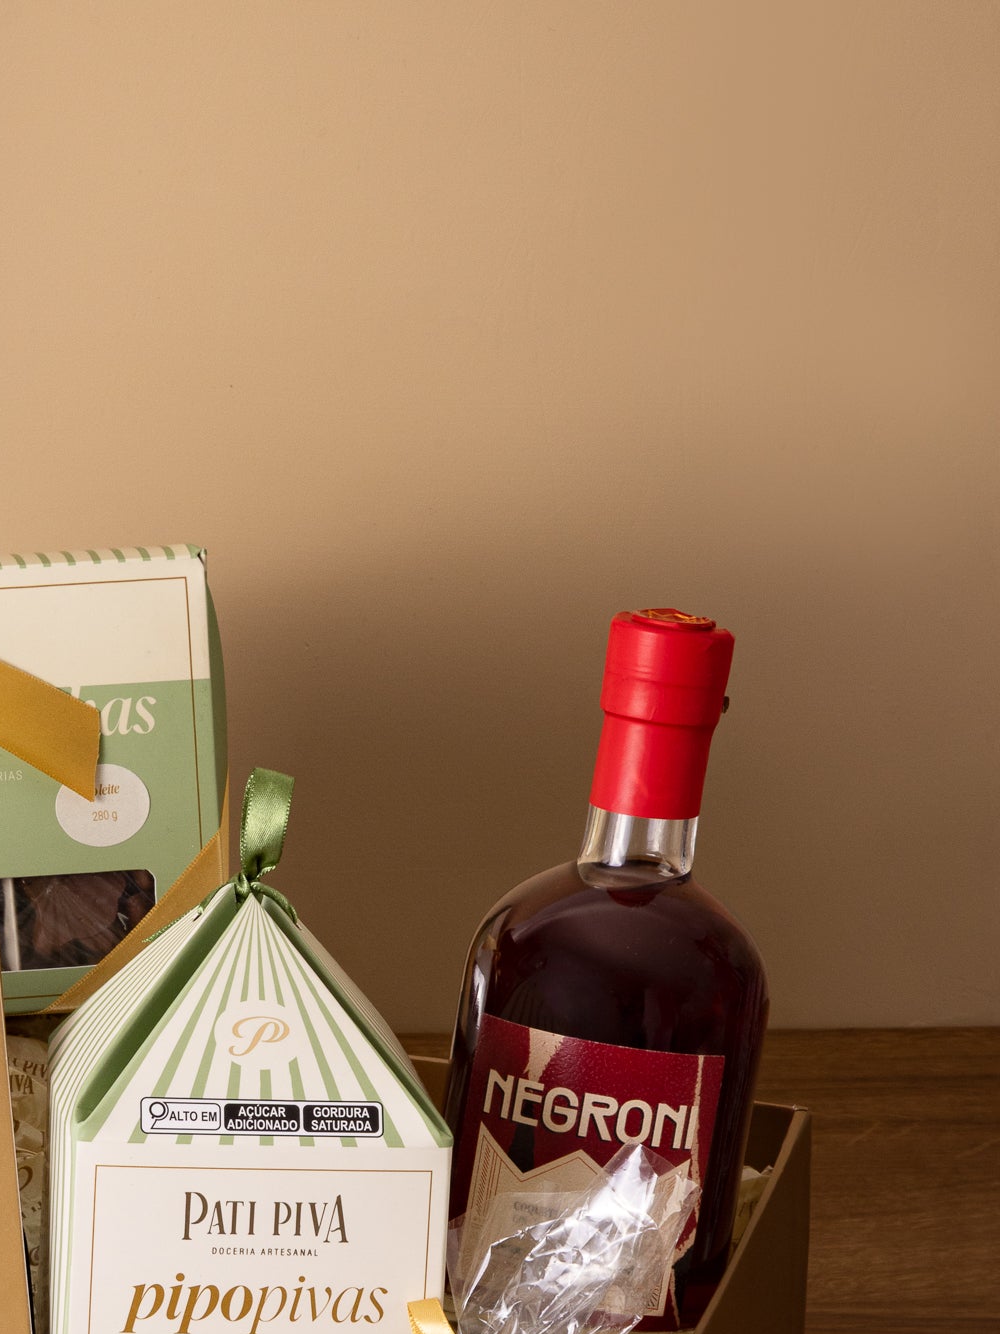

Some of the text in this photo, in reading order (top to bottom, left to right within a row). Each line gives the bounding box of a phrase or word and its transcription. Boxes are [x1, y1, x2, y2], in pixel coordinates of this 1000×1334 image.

[98, 784, 120, 796] leite
[92, 810, 118, 822] 280 g
[228, 1015, 290, 1057] P
[238, 1104, 287, 1121] AÇÚCAR
[313, 1107, 370, 1119] GORDURA
[483, 1068, 700, 1150] NEGRONI
[169, 1110, 218, 1122] ALTO EM
[227, 1118, 299, 1131] ADICIONADO
[311, 1120, 372, 1132] SATURADA
[181, 1191, 349, 1243] PATI PIVA
[211, 1247, 319, 1257] DOCERIA ARTESANAL
